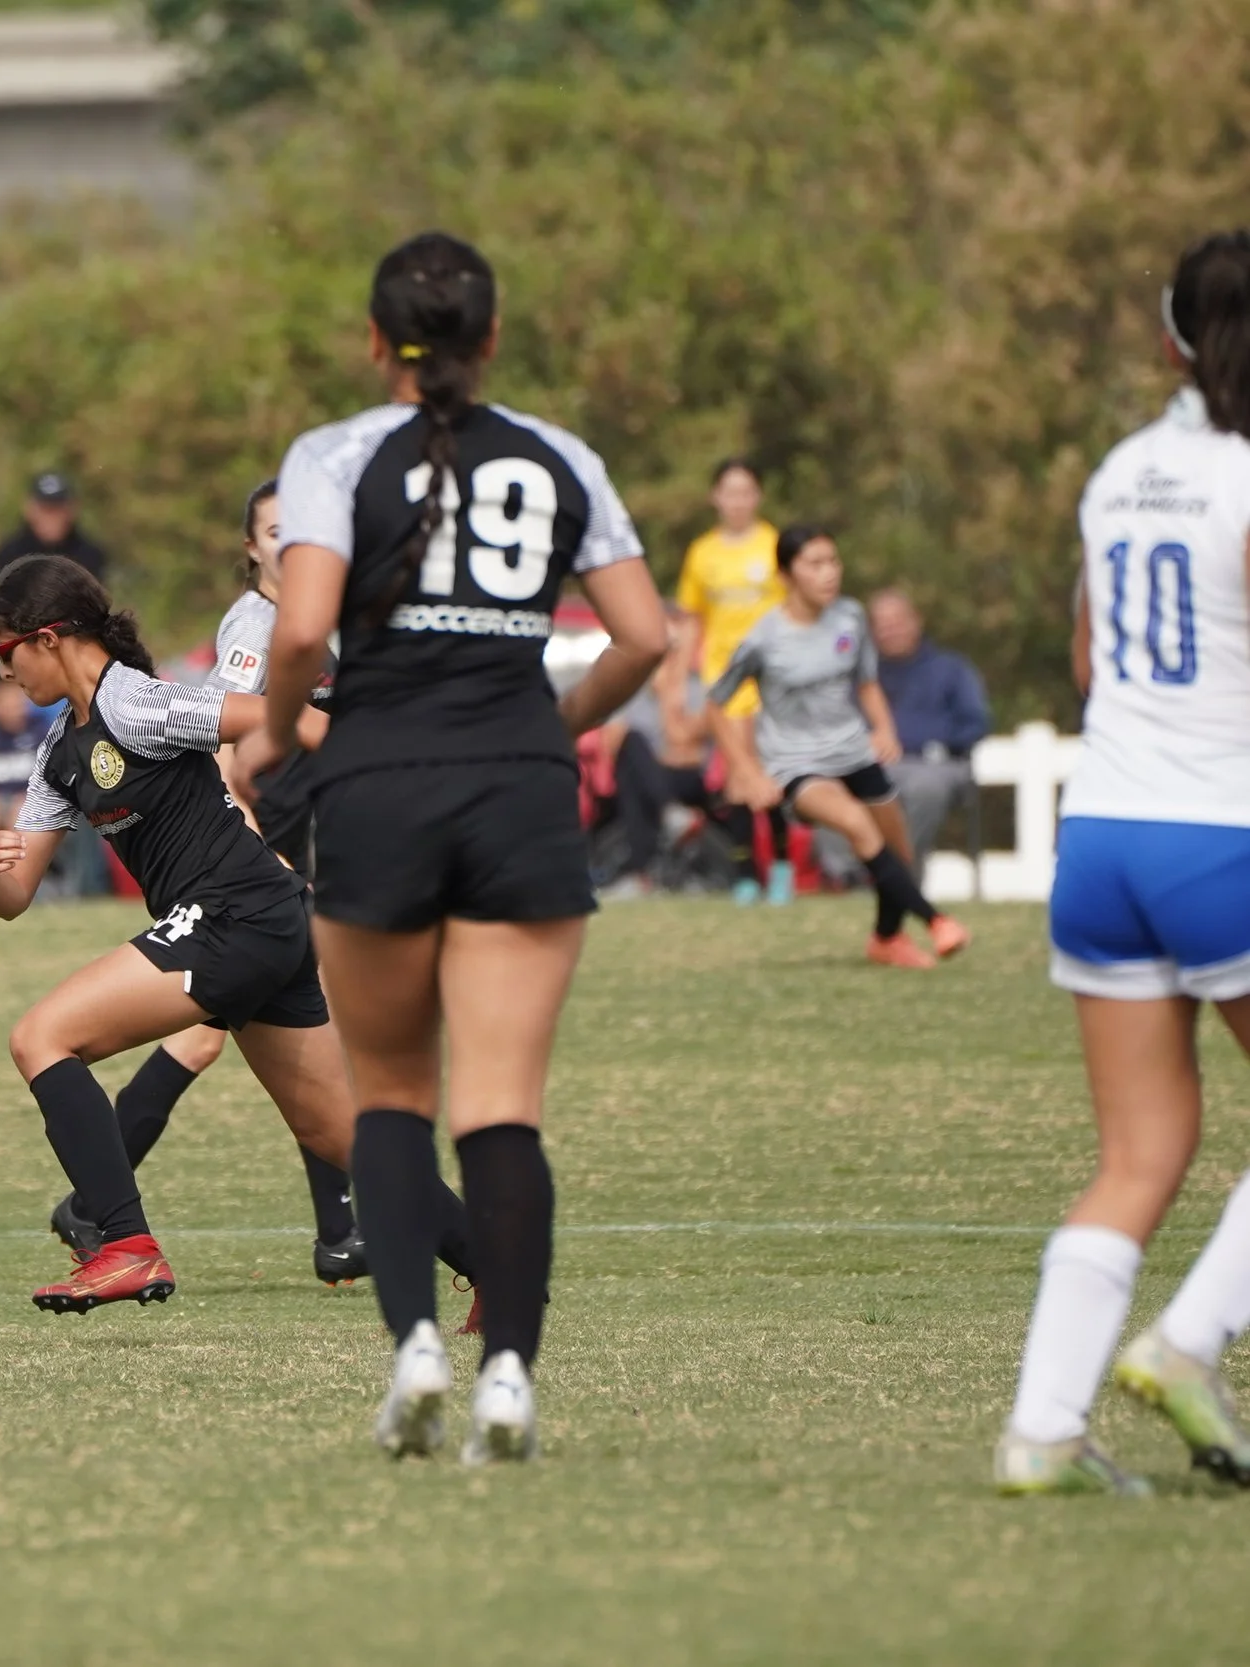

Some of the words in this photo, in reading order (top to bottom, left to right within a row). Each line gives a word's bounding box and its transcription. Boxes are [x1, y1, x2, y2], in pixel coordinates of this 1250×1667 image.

[404, 457, 557, 600] 19
[230, 650, 257, 670] DP
[1107, 541, 1197, 683] 10
